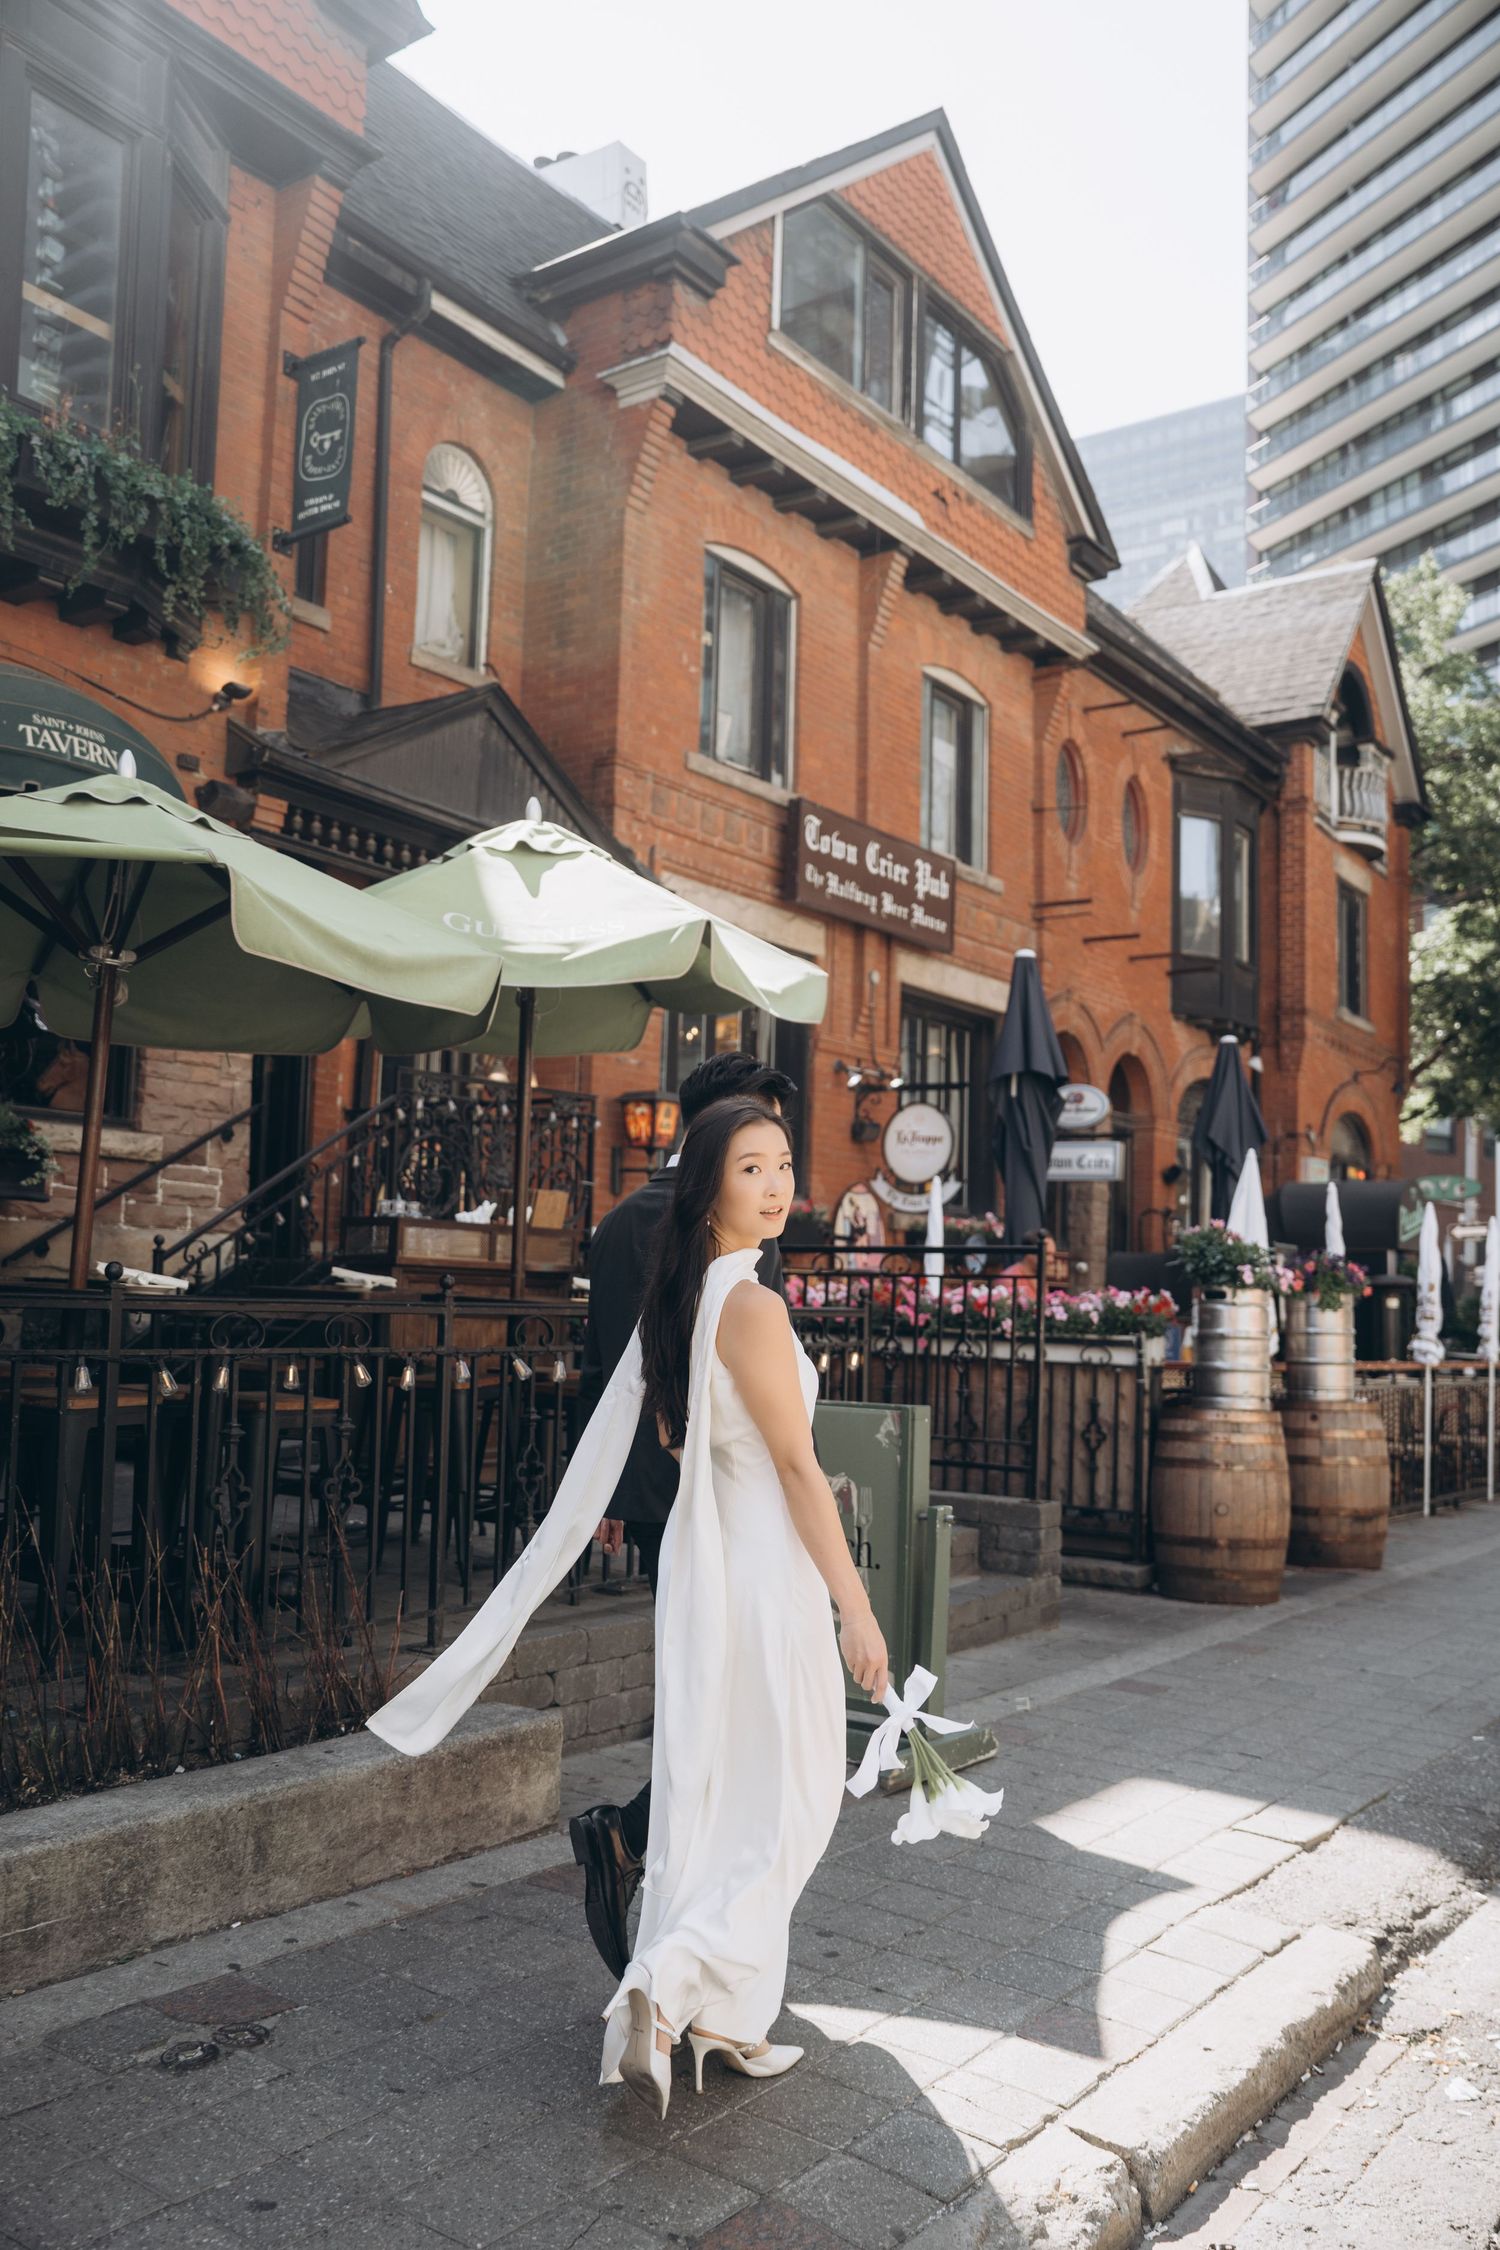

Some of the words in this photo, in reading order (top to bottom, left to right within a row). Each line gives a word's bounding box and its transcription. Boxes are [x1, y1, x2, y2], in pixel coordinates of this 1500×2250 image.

[18, 724, 119, 771] TAVERN
[32, 713, 67, 731] SAINT
[75, 724, 106, 744] JOHNS
[804, 814, 858, 866] Town
[865, 840, 910, 886] Crier
[914, 858, 950, 901] Pub
[442, 911, 626, 942] GUNESS
